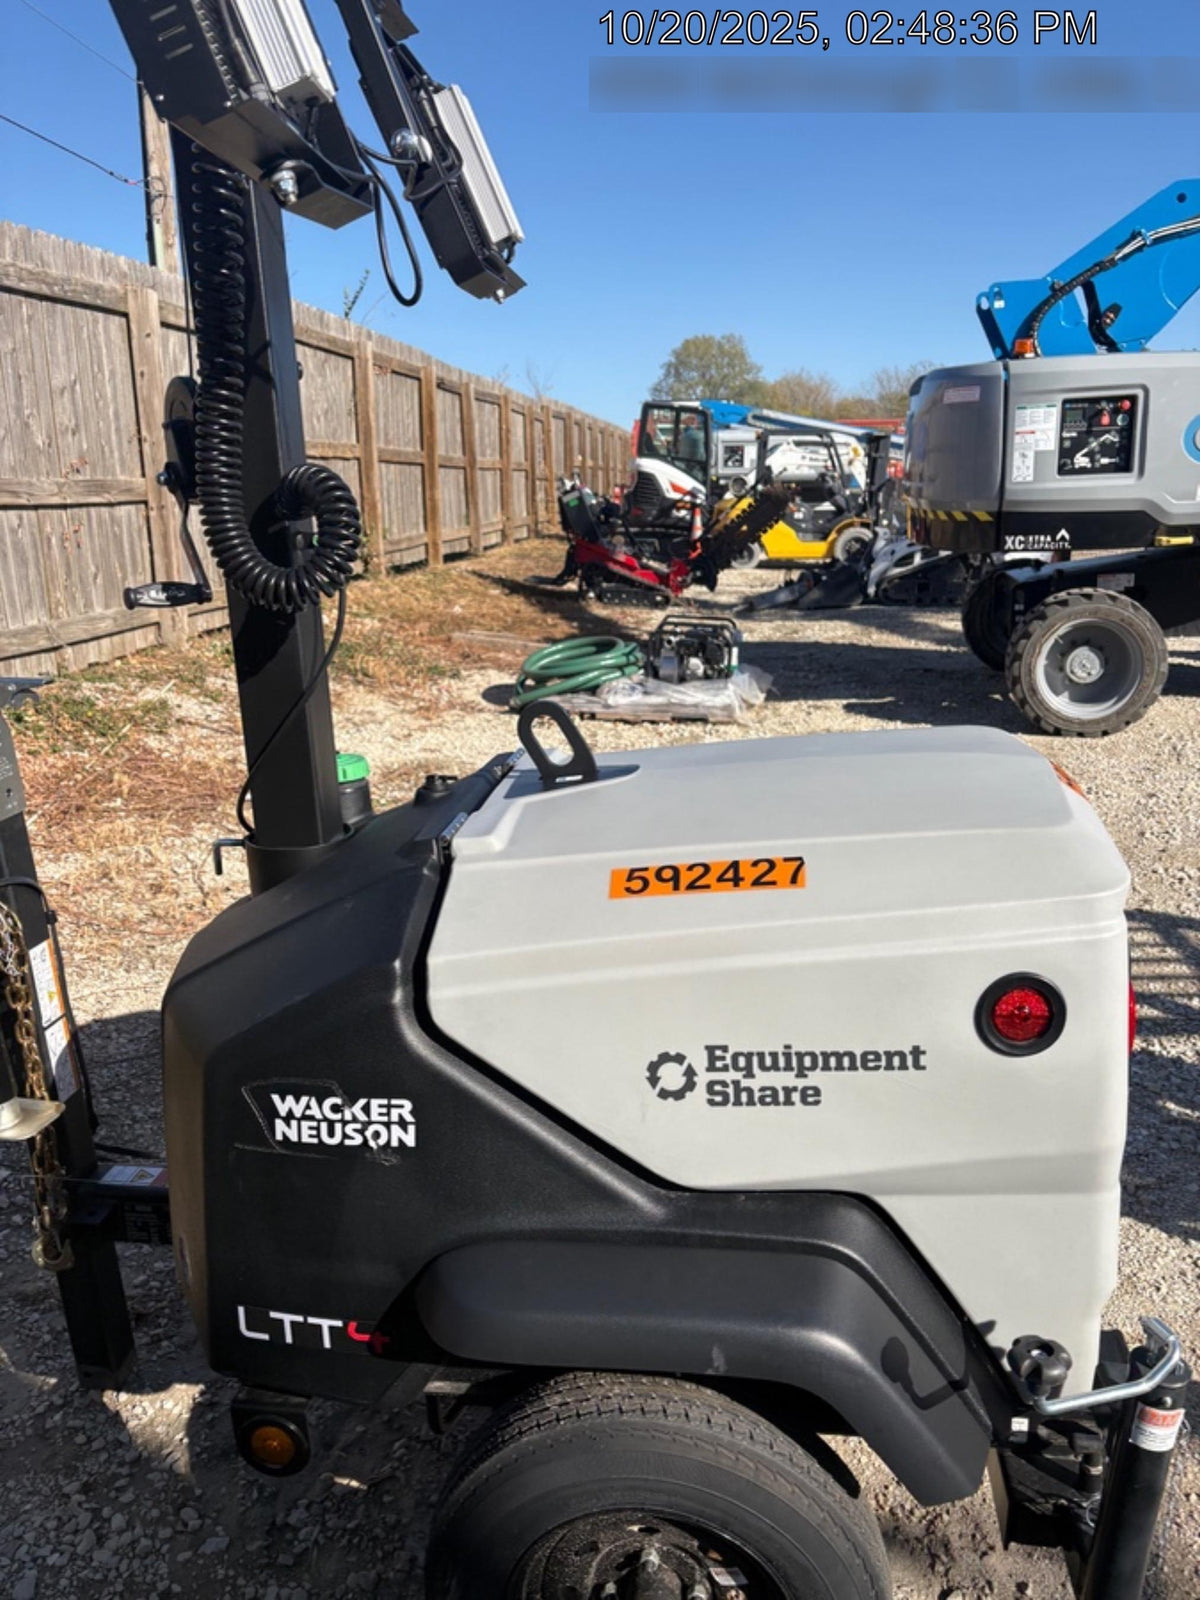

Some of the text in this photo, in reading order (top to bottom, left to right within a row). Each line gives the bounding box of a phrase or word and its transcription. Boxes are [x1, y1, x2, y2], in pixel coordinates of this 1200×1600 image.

[1004, 534, 1025, 550] XC
[623, 856, 805, 895] 592427
[704, 1044, 927, 1079] Equipment
[270, 1093, 416, 1123] WACKER
[705, 1079, 822, 1107] Share
[274, 1118, 417, 1148] NEUSON
